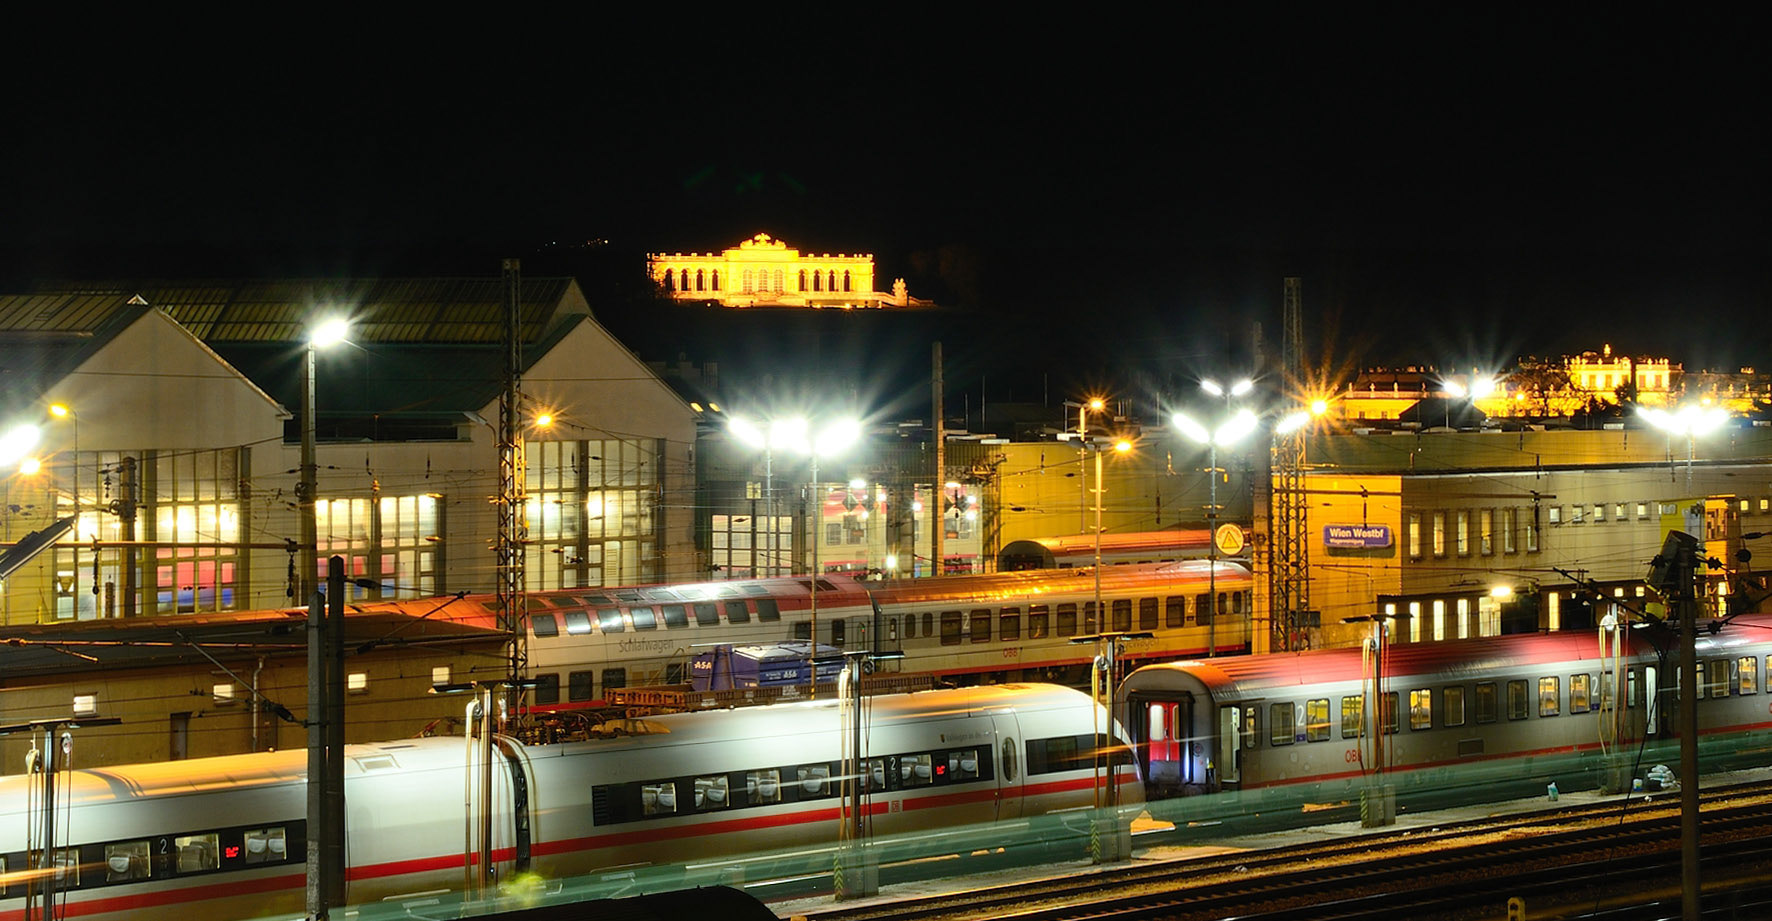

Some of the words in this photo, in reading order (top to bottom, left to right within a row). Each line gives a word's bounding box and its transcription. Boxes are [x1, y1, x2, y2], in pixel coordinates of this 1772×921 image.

[1329, 527, 1352, 538] Wien
[1353, 527, 1384, 539] Westbf
[1187, 596, 1194, 614] 2
[962, 612, 970, 630] 2
[619, 637, 674, 654] Schlafwagen
[1731, 660, 1738, 680] 2
[1591, 675, 1599, 696] 2
[1297, 704, 1305, 727] 2
[890, 757, 896, 771] 2
[160, 838, 167, 855] 2
